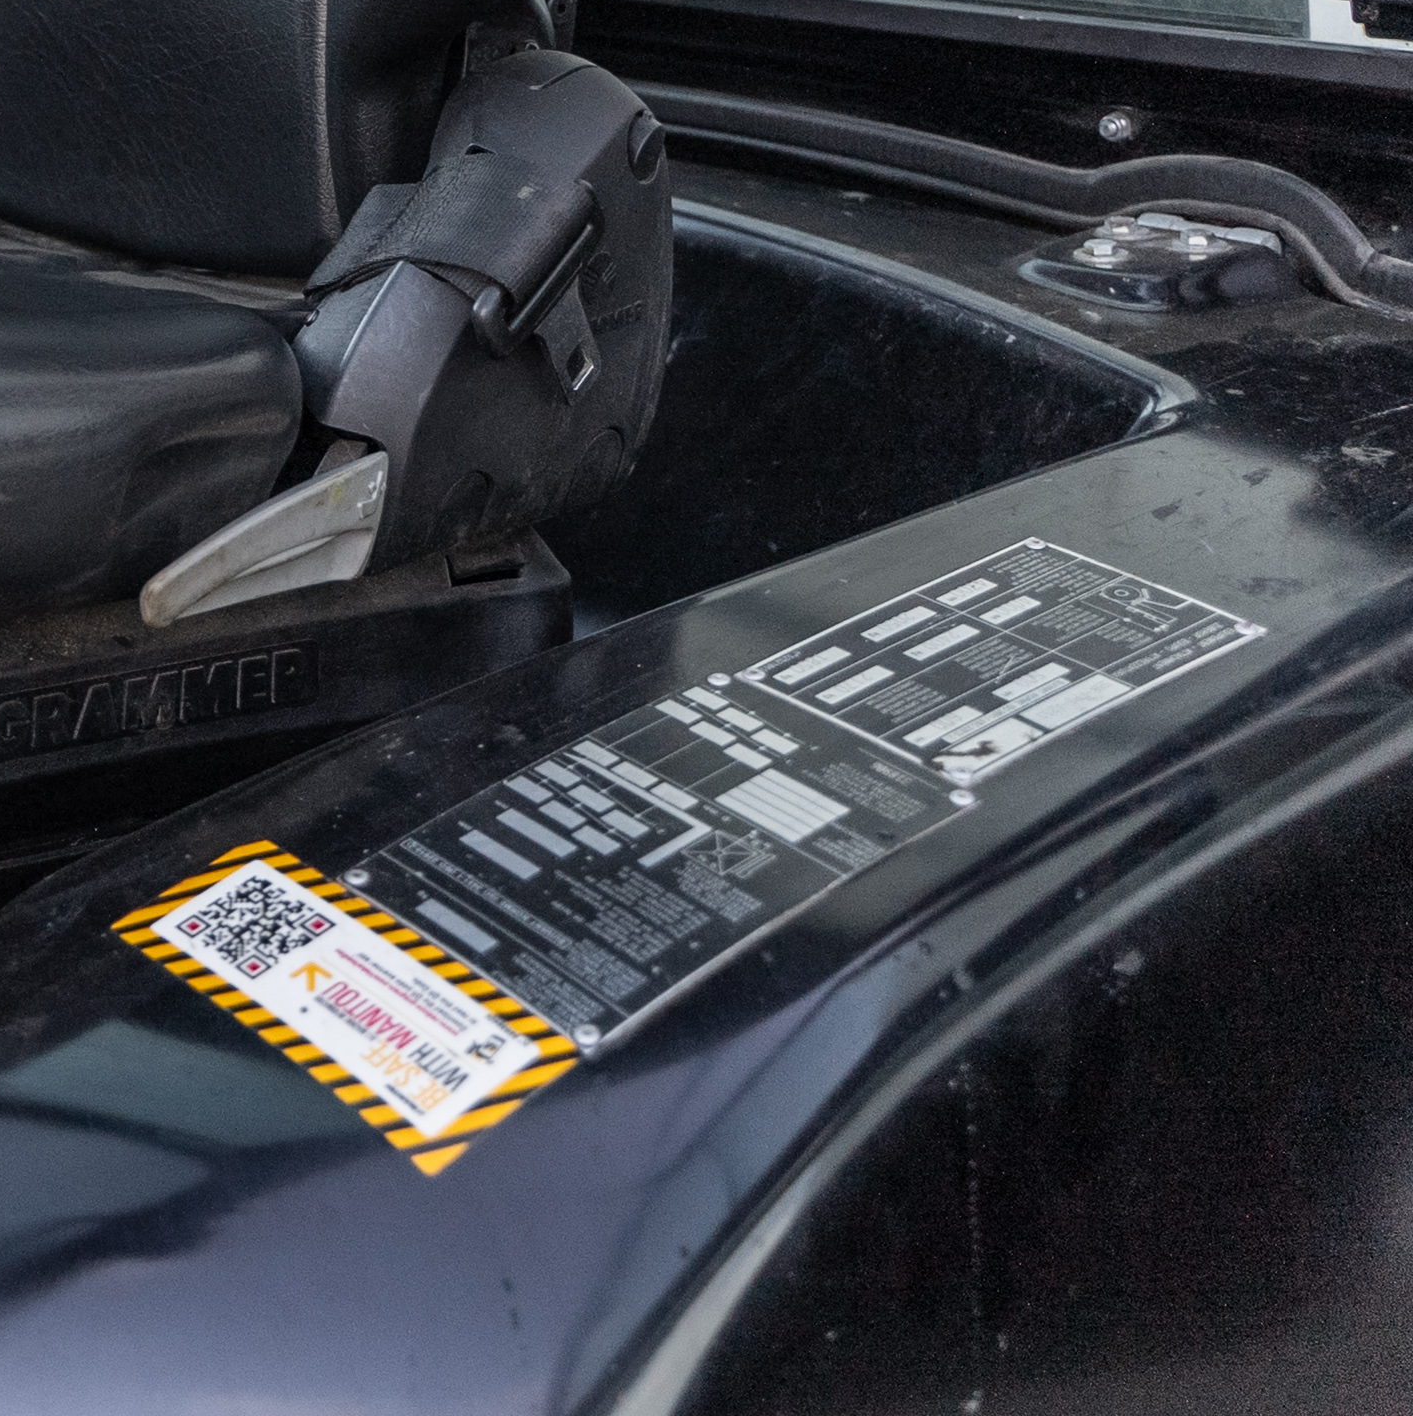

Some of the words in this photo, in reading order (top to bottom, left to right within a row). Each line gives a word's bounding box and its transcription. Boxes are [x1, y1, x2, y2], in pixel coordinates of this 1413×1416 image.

[322, 981, 418, 1051] MANITOU
[362, 1039, 421, 1087] SAFE
[407, 1042, 469, 1093] WITH
[410, 1076, 450, 1111] BE
